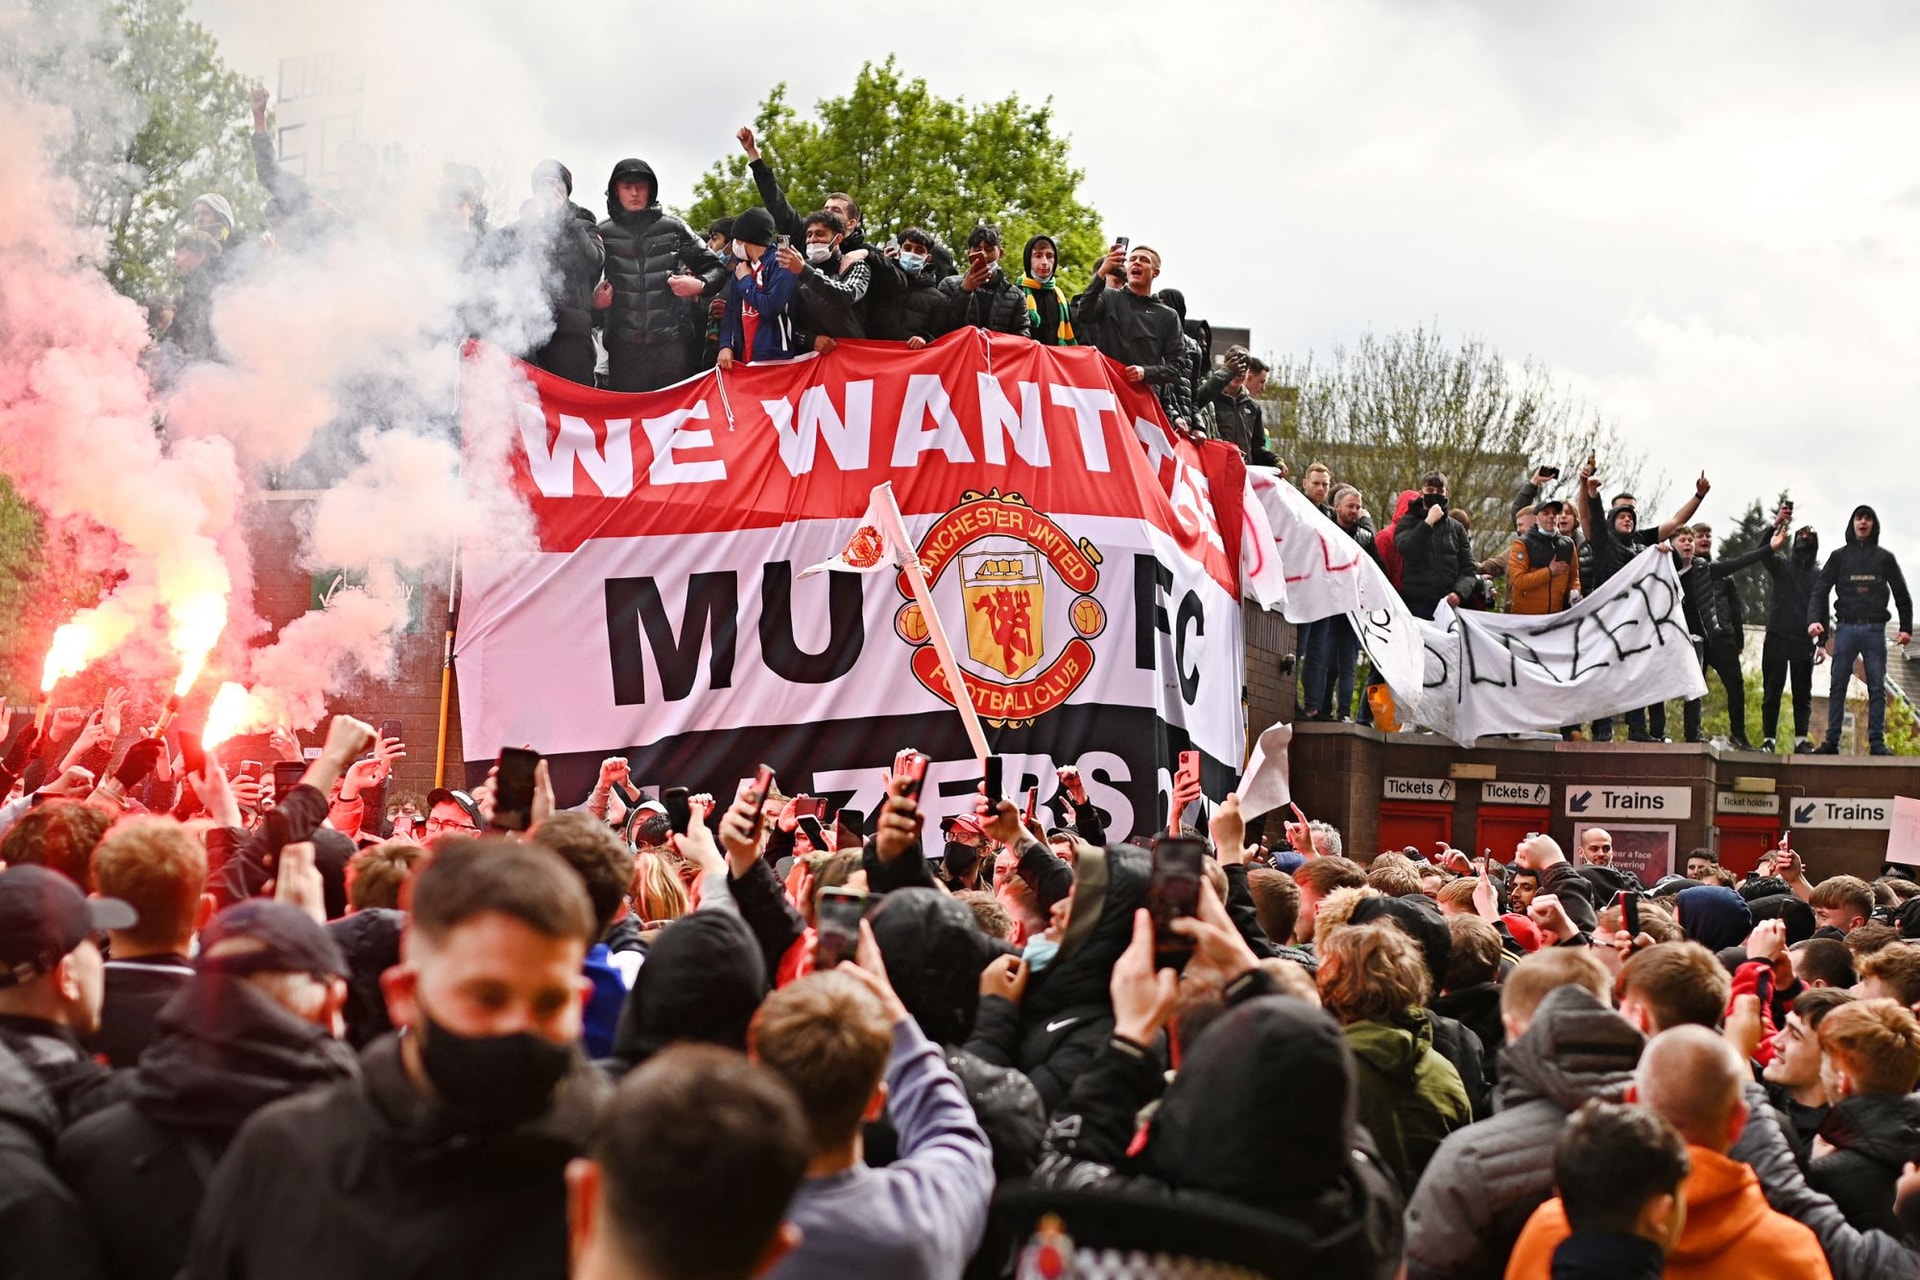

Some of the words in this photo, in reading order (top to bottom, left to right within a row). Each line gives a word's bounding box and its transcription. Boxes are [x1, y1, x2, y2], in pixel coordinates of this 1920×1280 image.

[515, 399, 728, 498] WE
[760, 371, 1118, 477] WANT
[920, 507, 1024, 579] ANCHESTER
[1028, 518, 1088, 581] UNITED
[605, 560, 864, 705] MU
[1134, 553, 1204, 706] FC
[1034, 658, 1079, 704] CLUB
[1388, 780, 1434, 794] Tickets
[1486, 784, 1529, 798] Tickets
[1601, 791, 1664, 809] Trains
[1724, 797, 1745, 806] Ticket
[1747, 798, 1773, 808] holders
[1824, 803, 1884, 821] Trains
[1635, 850, 1652, 859] face
[1612, 861, 1645, 871] overing
